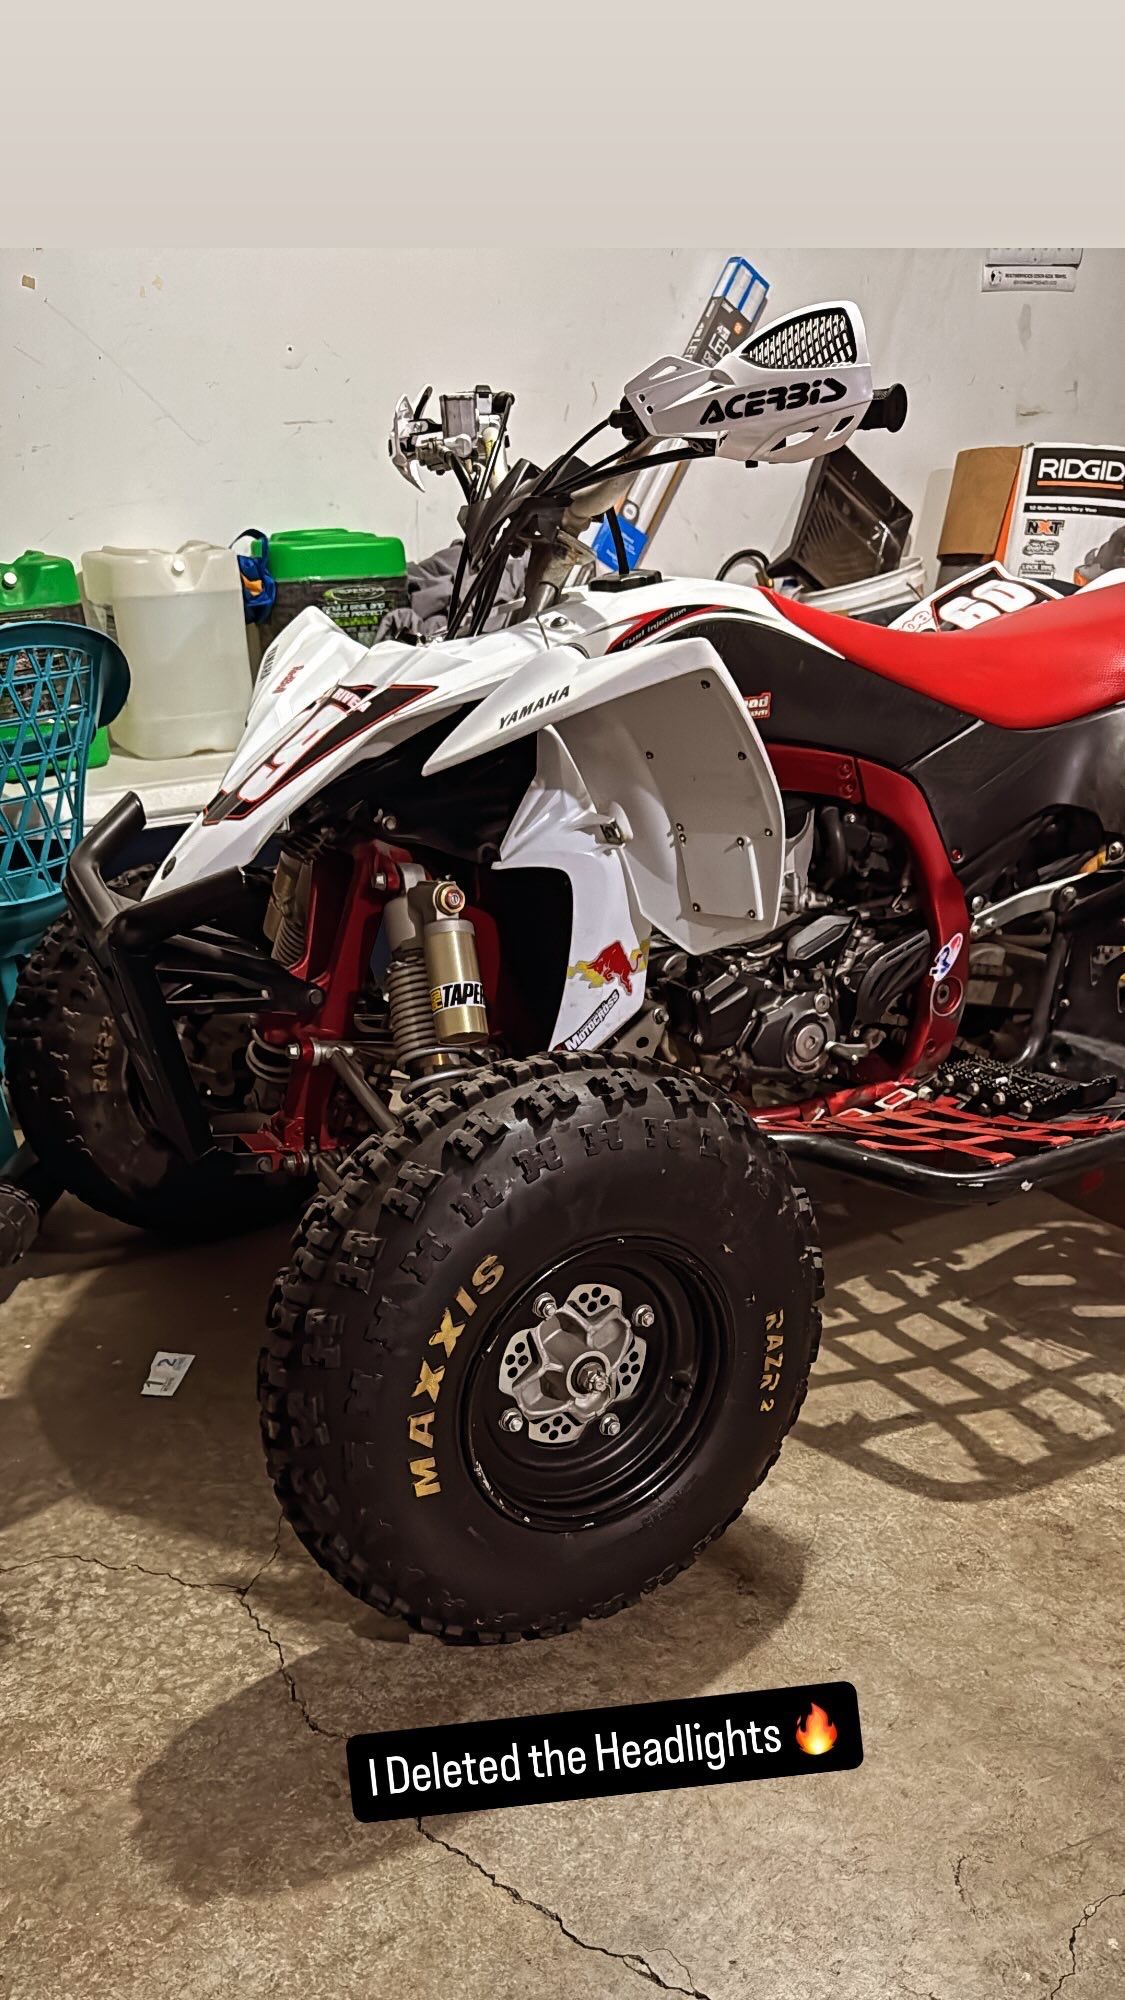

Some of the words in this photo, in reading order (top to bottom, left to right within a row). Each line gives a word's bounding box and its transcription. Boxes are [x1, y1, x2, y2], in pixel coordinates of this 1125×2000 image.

[1038, 457, 1125, 482] RIDGID
[1027, 520, 1062, 535] NXT
[623, 629, 645, 648] Fuel
[647, 606, 687, 633] Injection
[499, 685, 570, 730] YAMAHA
[759, 1308, 784, 1391] RAZR
[408, 1254, 505, 1498] MAXXIS
[759, 1398, 775, 1413] 2
